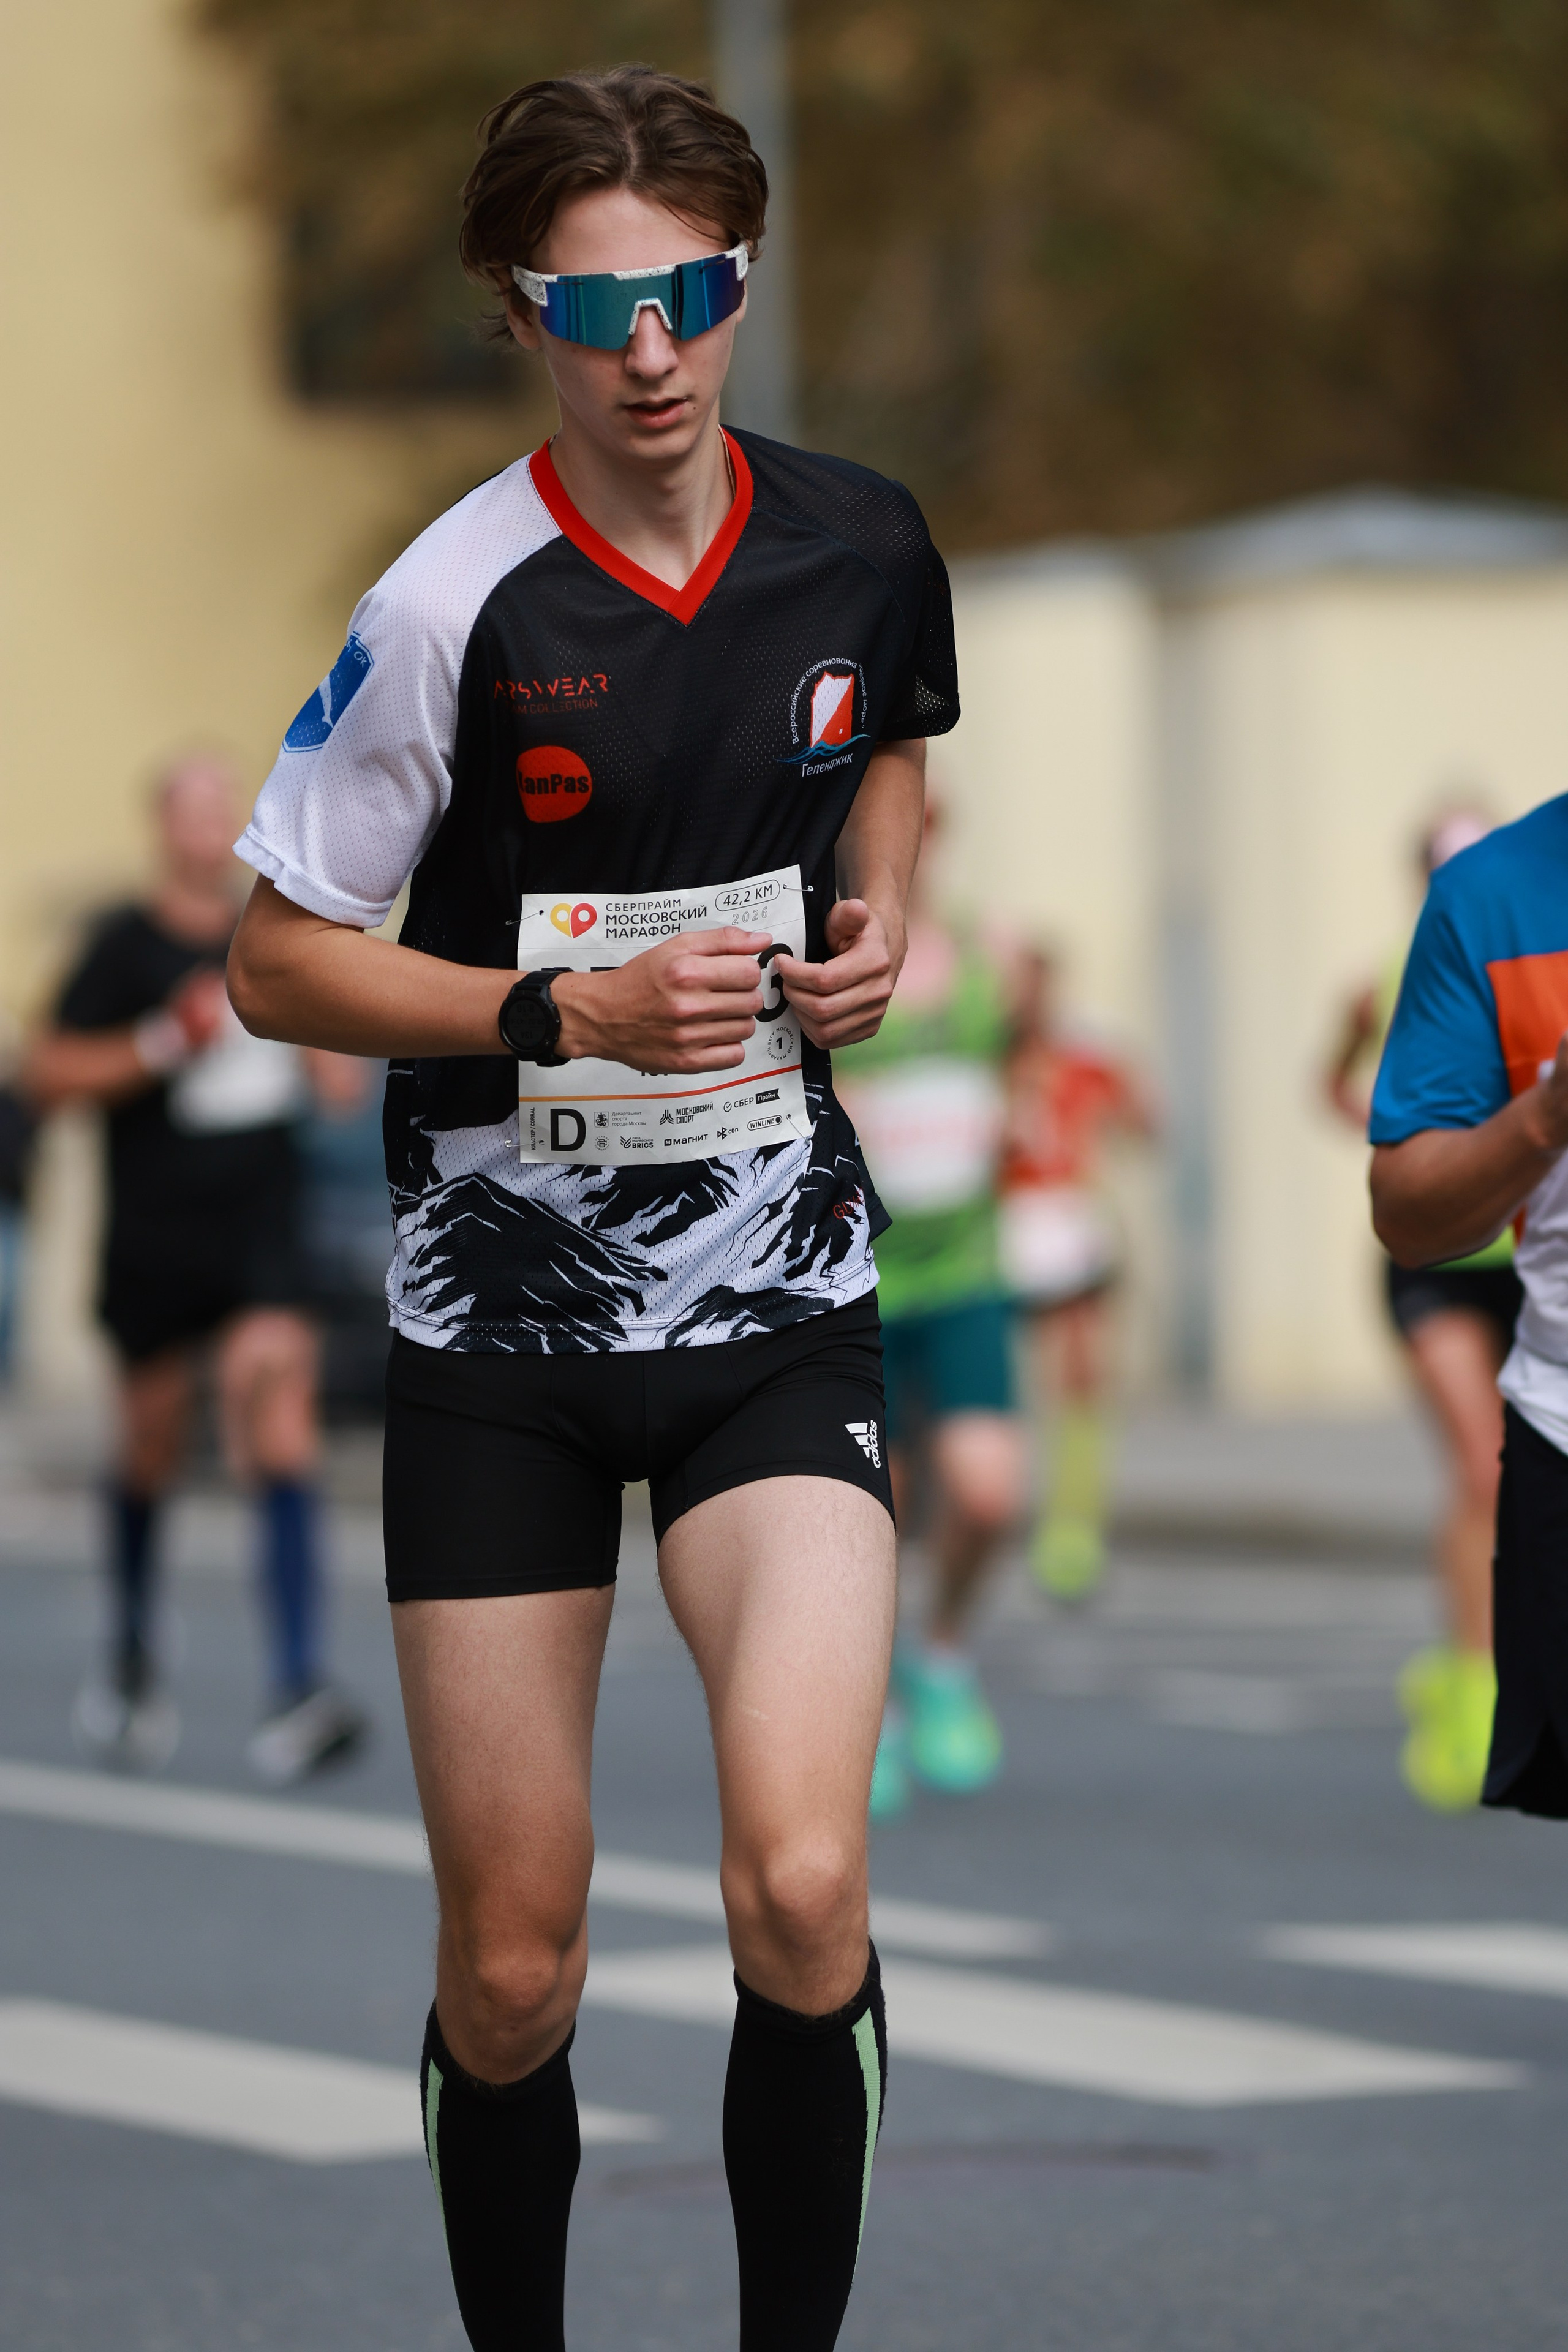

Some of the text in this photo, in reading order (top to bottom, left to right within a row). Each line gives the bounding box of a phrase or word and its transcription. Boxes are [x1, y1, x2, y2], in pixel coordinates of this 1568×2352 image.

[530, 699, 598, 714] COLLECTION
[790, 676, 807, 744] Всероссийские
[805, 658, 857, 677] соревнования
[801, 753, 853, 777] Геленджик
[723, 884, 774, 907] 42,2 КМ
[606, 898, 682, 912] СБЕРПРАЙМ
[606, 905, 707, 925] МОСКОВСКИЙ
[731, 907, 769, 925] 2026
[606, 923, 681, 938] МАРАФОН
[776, 1027, 794, 1054] МОСКОВСКИЙ
[776, 1037, 782, 1049] 1
[767, 1047, 786, 1060] МАРАФОН
[676, 1101, 714, 1116] МОСКОВСКИЙ
[734, 1093, 776, 1109] СБЕР Прайм
[676, 1115, 695, 1125] СПОРТ
[750, 1118, 775, 1129] WINLINE
[550, 1108, 586, 1152] D
[867, 1420, 881, 1469] adidas
